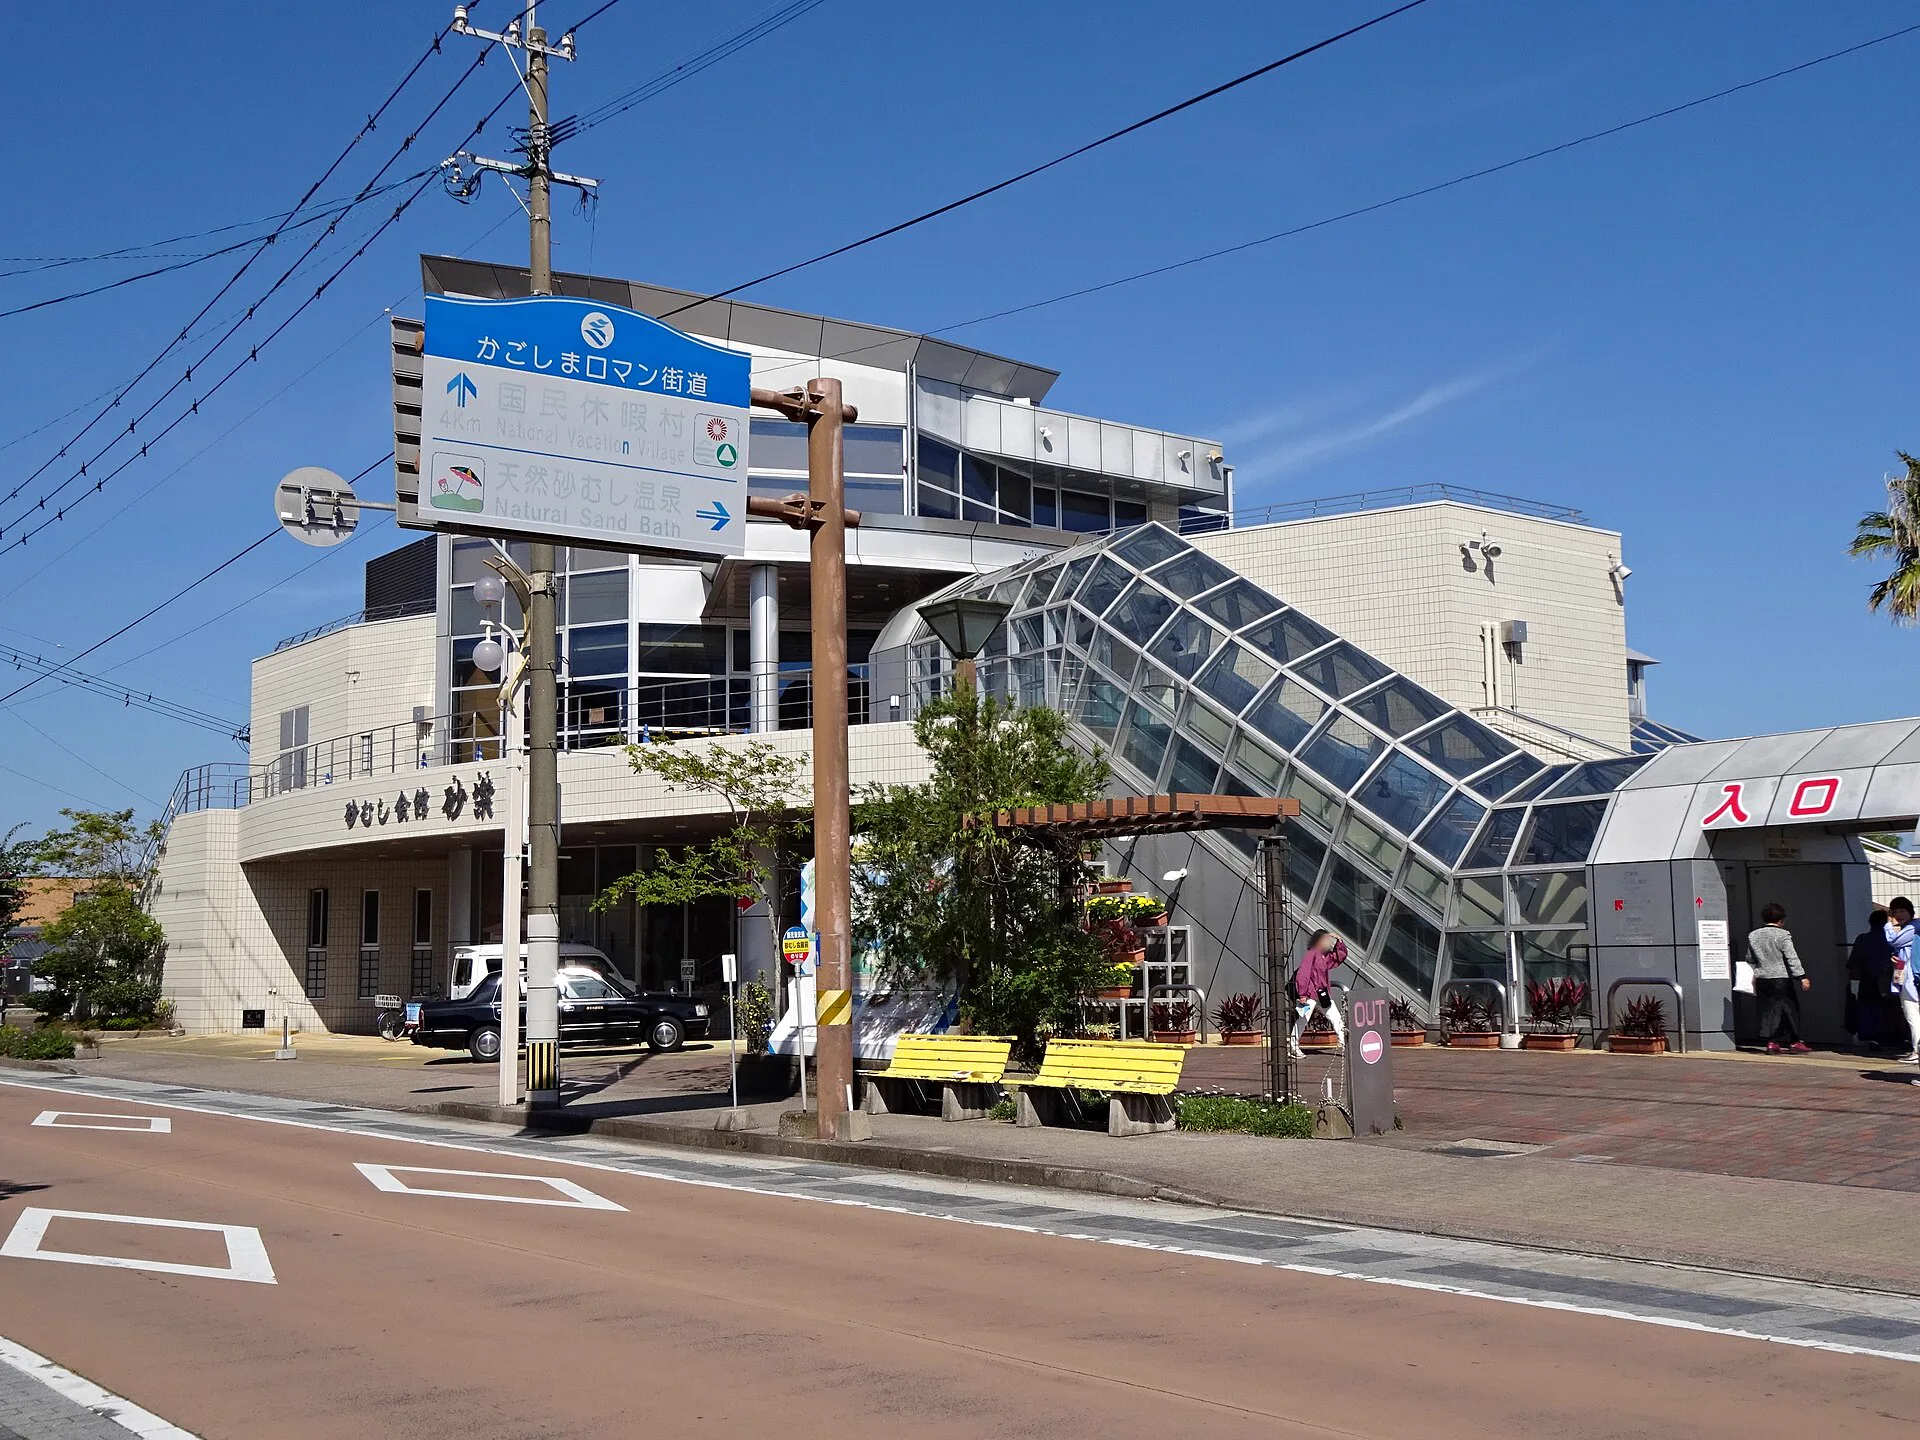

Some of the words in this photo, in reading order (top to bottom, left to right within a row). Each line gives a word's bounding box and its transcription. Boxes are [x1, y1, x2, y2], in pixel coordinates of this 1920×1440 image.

[477, 335, 708, 397] かごしまロマン街道
[439, 409, 482, 433] 4Km
[498, 382, 687, 438] 国民休暇村
[496, 416, 558, 445] National
[567, 429, 630, 455] Vacation
[637, 439, 686, 464] Village
[495, 461, 682, 516] 天然砂むし温泉
[494, 497, 568, 525] Natural
[579, 507, 627, 533] Sand
[640, 515, 681, 538] Bath
[1702, 777, 1841, 826] 入口
[1354, 1000, 1385, 1027] OUT
